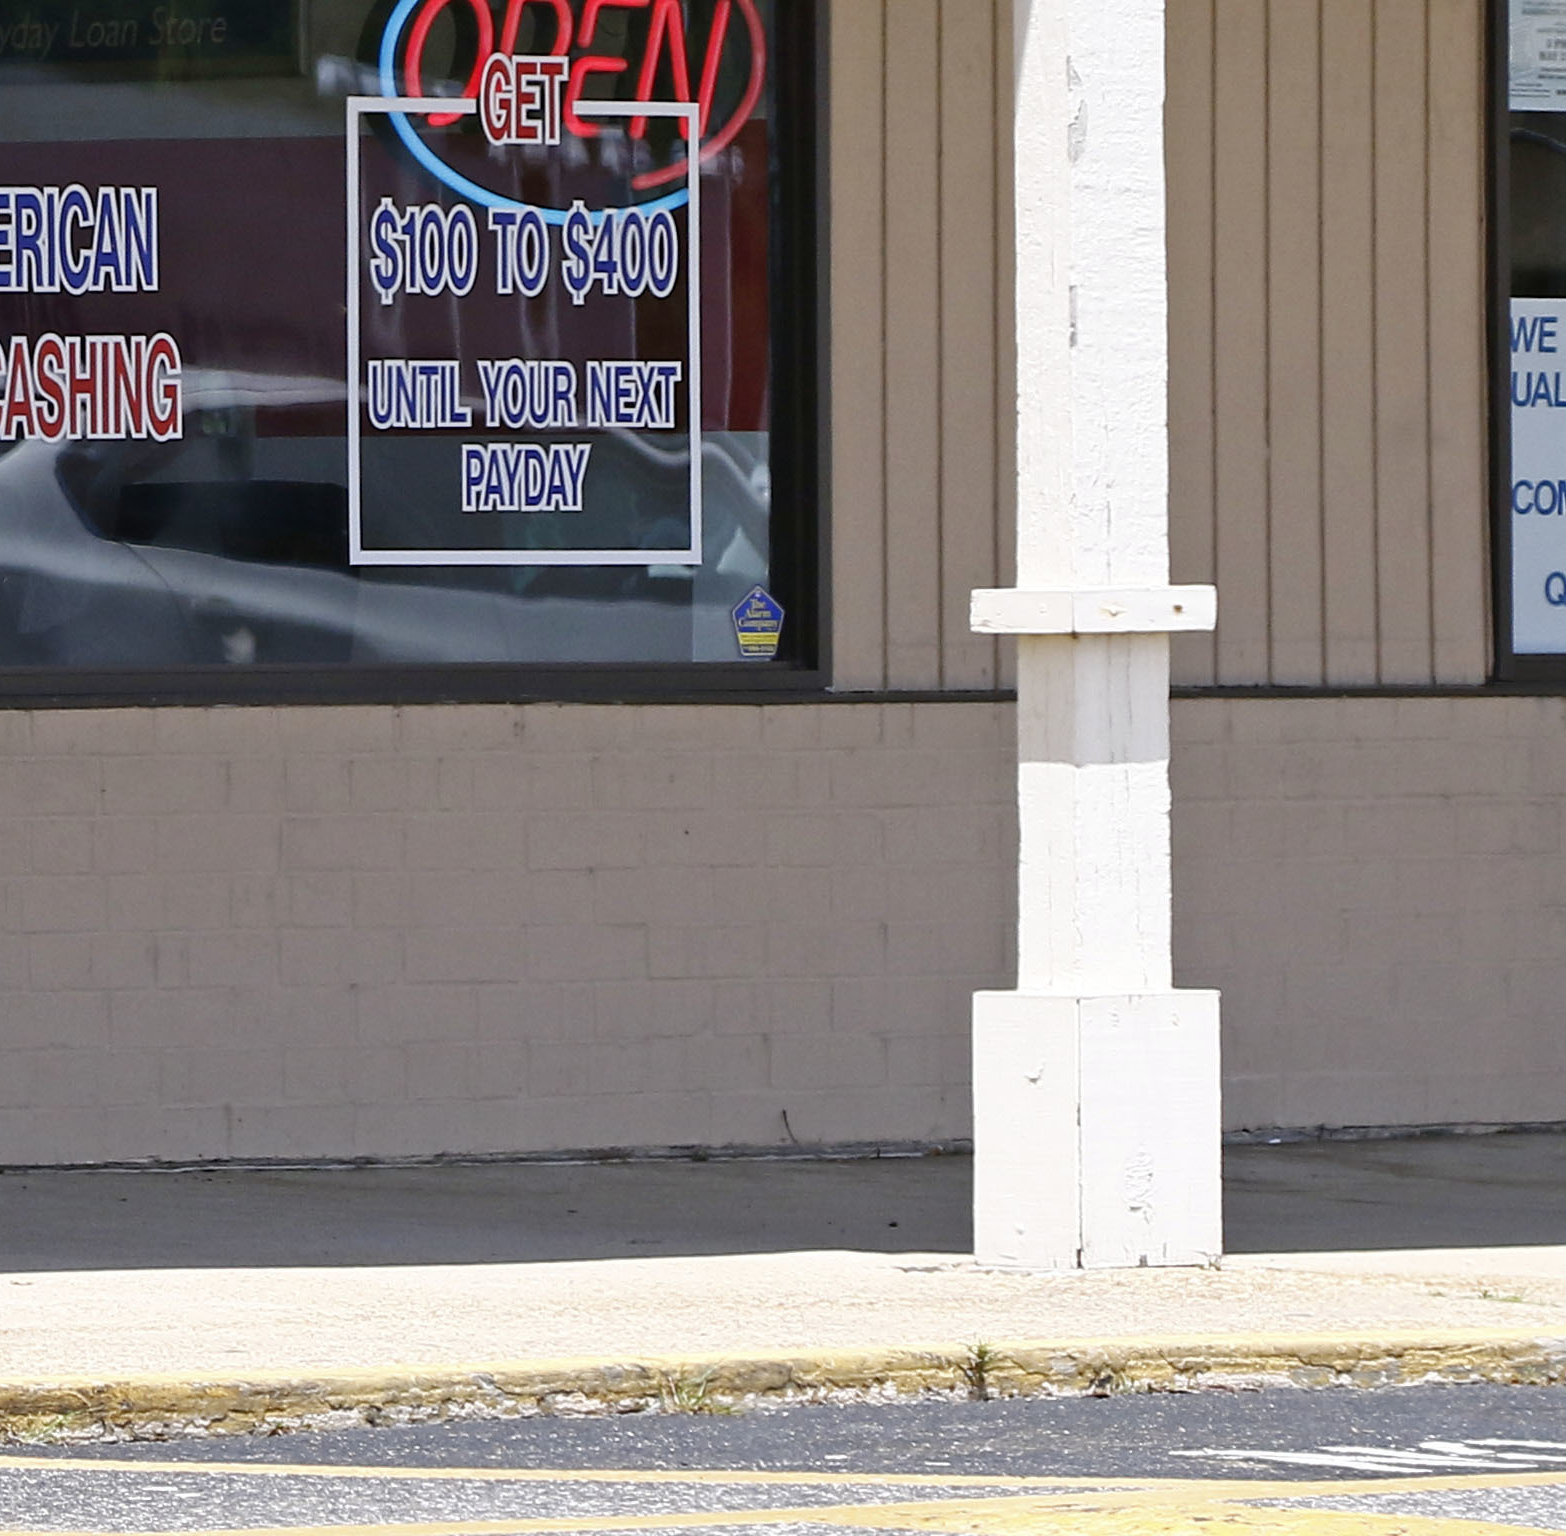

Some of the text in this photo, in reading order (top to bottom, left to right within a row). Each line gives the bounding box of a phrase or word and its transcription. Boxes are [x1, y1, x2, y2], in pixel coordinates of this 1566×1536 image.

[68, 9, 139, 50] Loan
[149, 4, 230, 46] Store
[480, 52, 569, 145] GET
[369, 197, 679, 305] $100 TO $400
[1511, 316, 1558, 353] WE
[368, 358, 681, 430] UNTIL YOUR NEXT
[462, 443, 592, 512] PAYDAY
